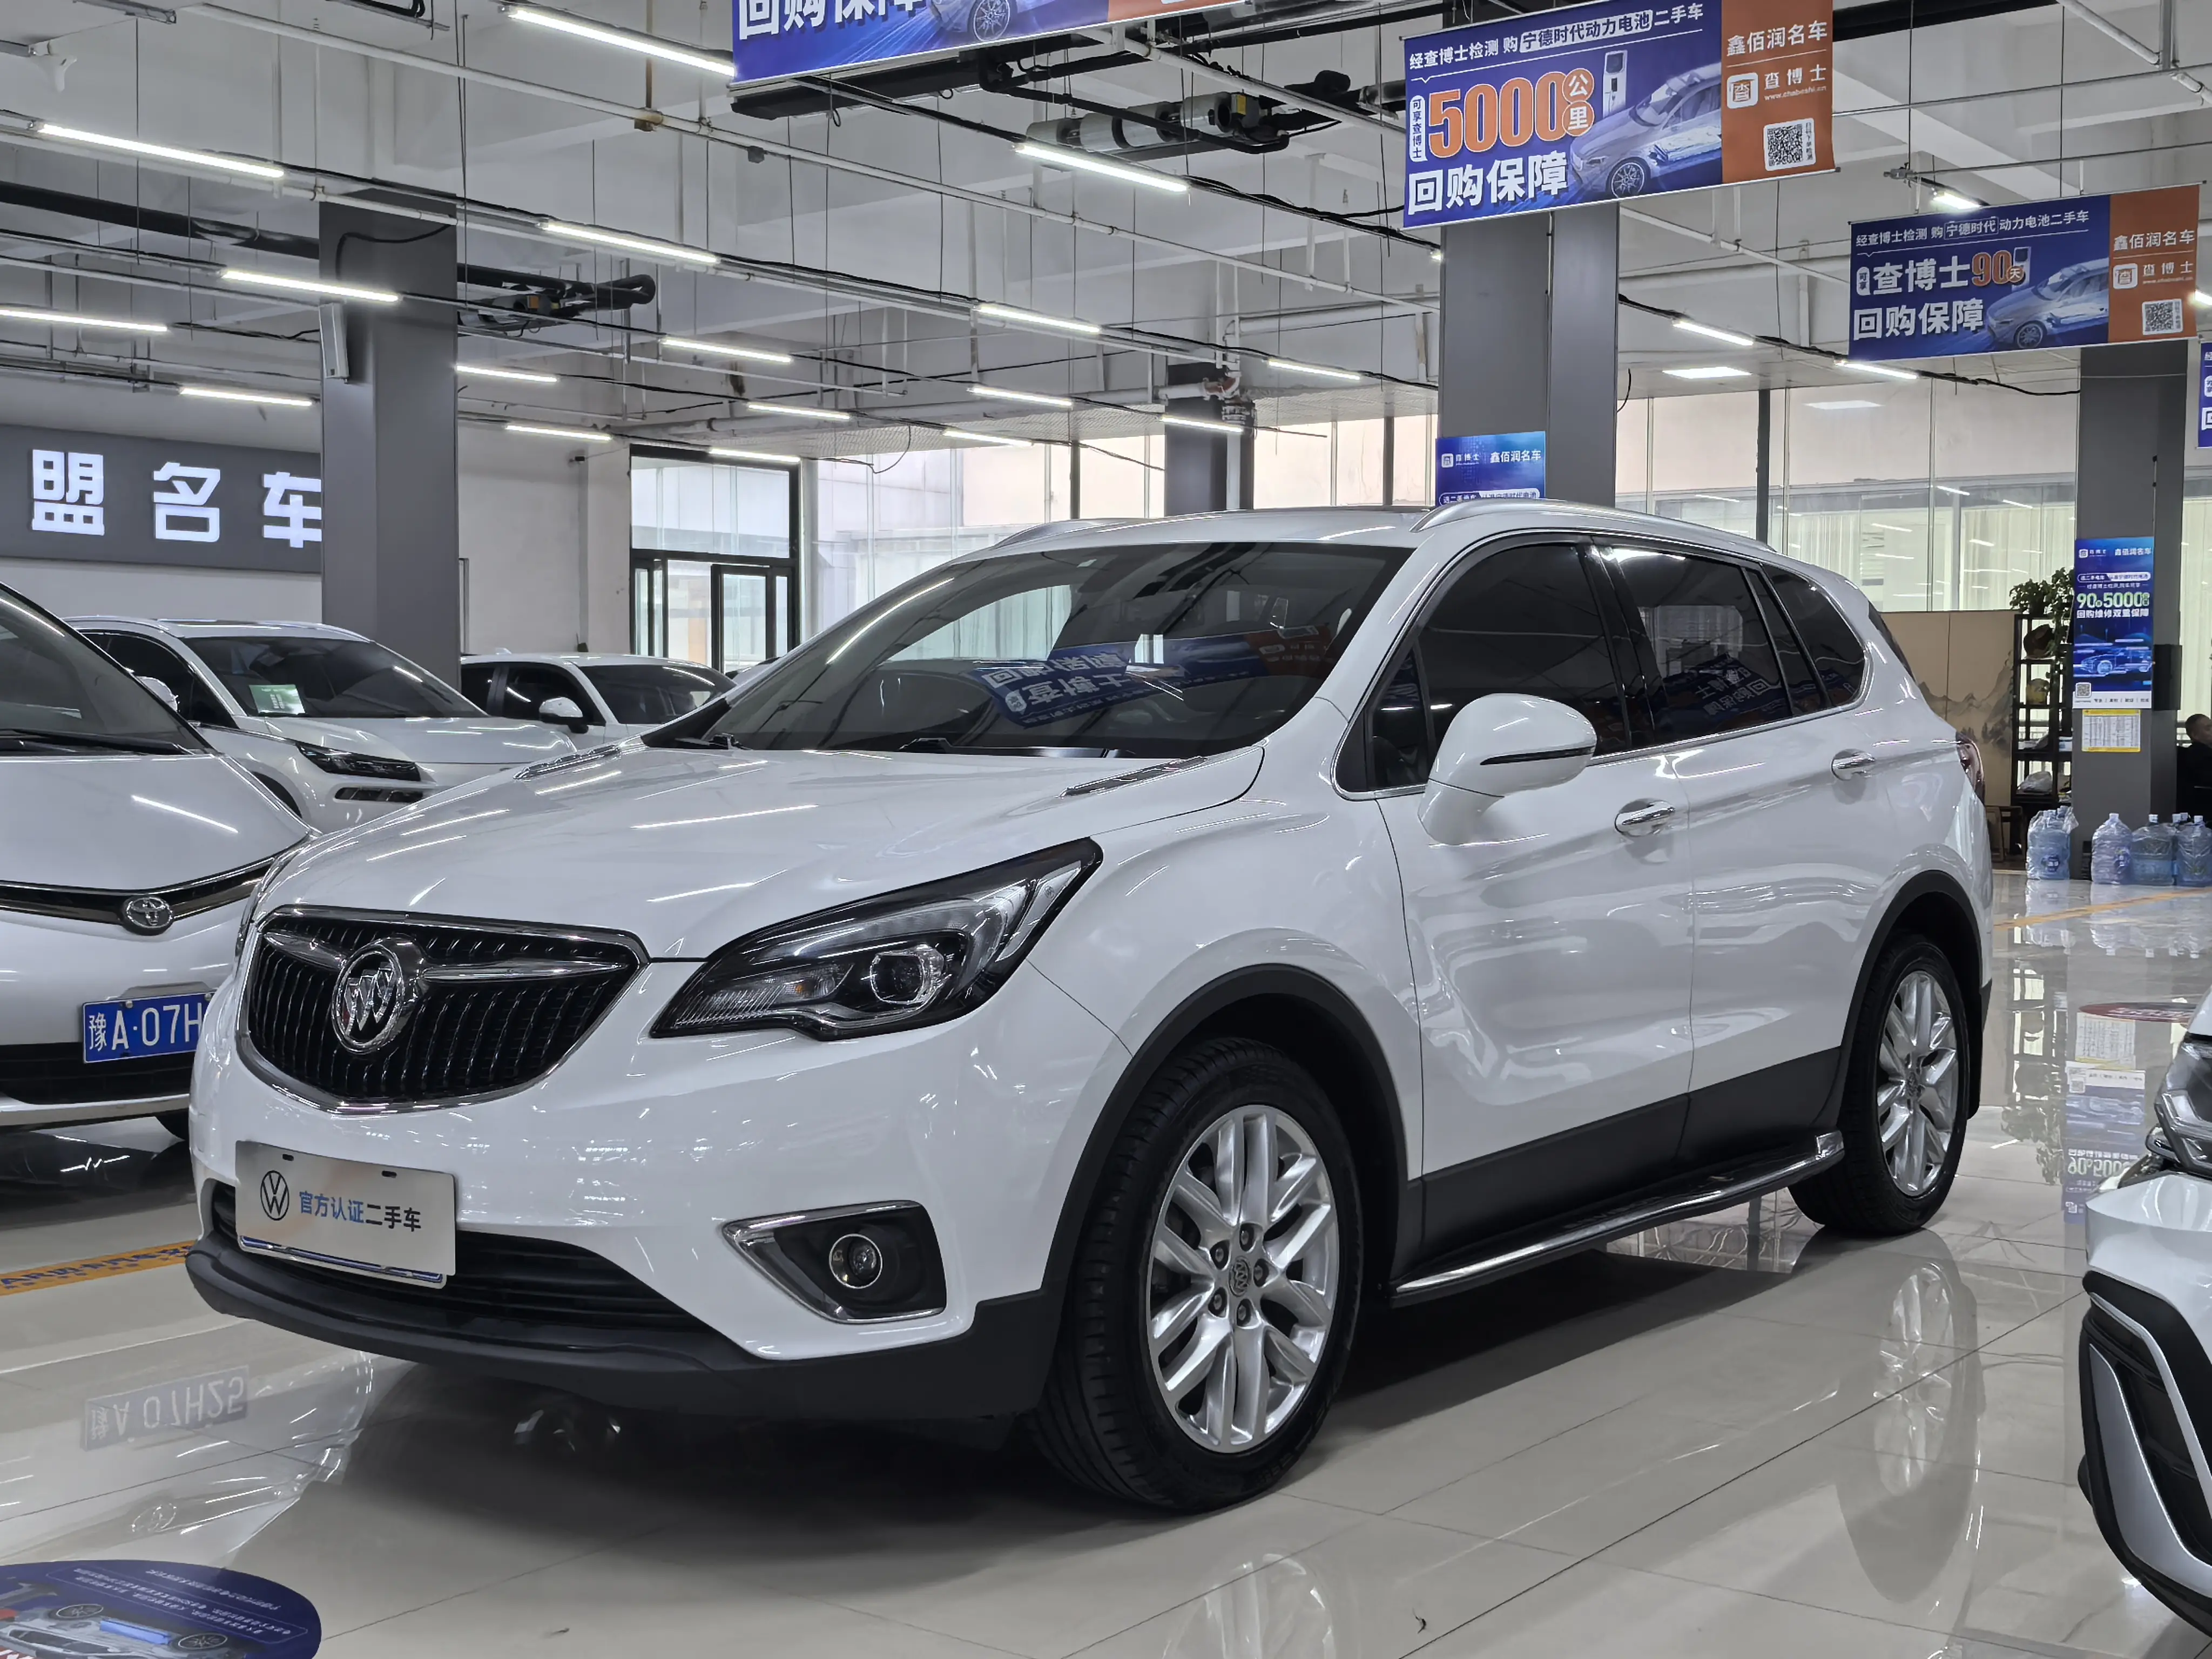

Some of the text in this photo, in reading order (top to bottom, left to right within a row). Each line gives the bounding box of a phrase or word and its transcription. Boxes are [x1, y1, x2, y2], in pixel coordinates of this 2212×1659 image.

[1410, 39, 1499, 70] 经查博士检测
[1727, 20, 1828, 57] 鑫佰润名车
[1412, 99, 1422, 158] 可享查博士
[1428, 71, 1567, 158] 5000
[1408, 150, 1569, 215] 回购保障
[1856, 227, 1927, 247] 经查博士检测
[2113, 229, 2195, 252] 鑫佰润名车
[1873, 255, 1970, 295] 查博士
[1854, 298, 1984, 341] 回购保障
[299, 1191, 422, 1232] 官方认证二手车
